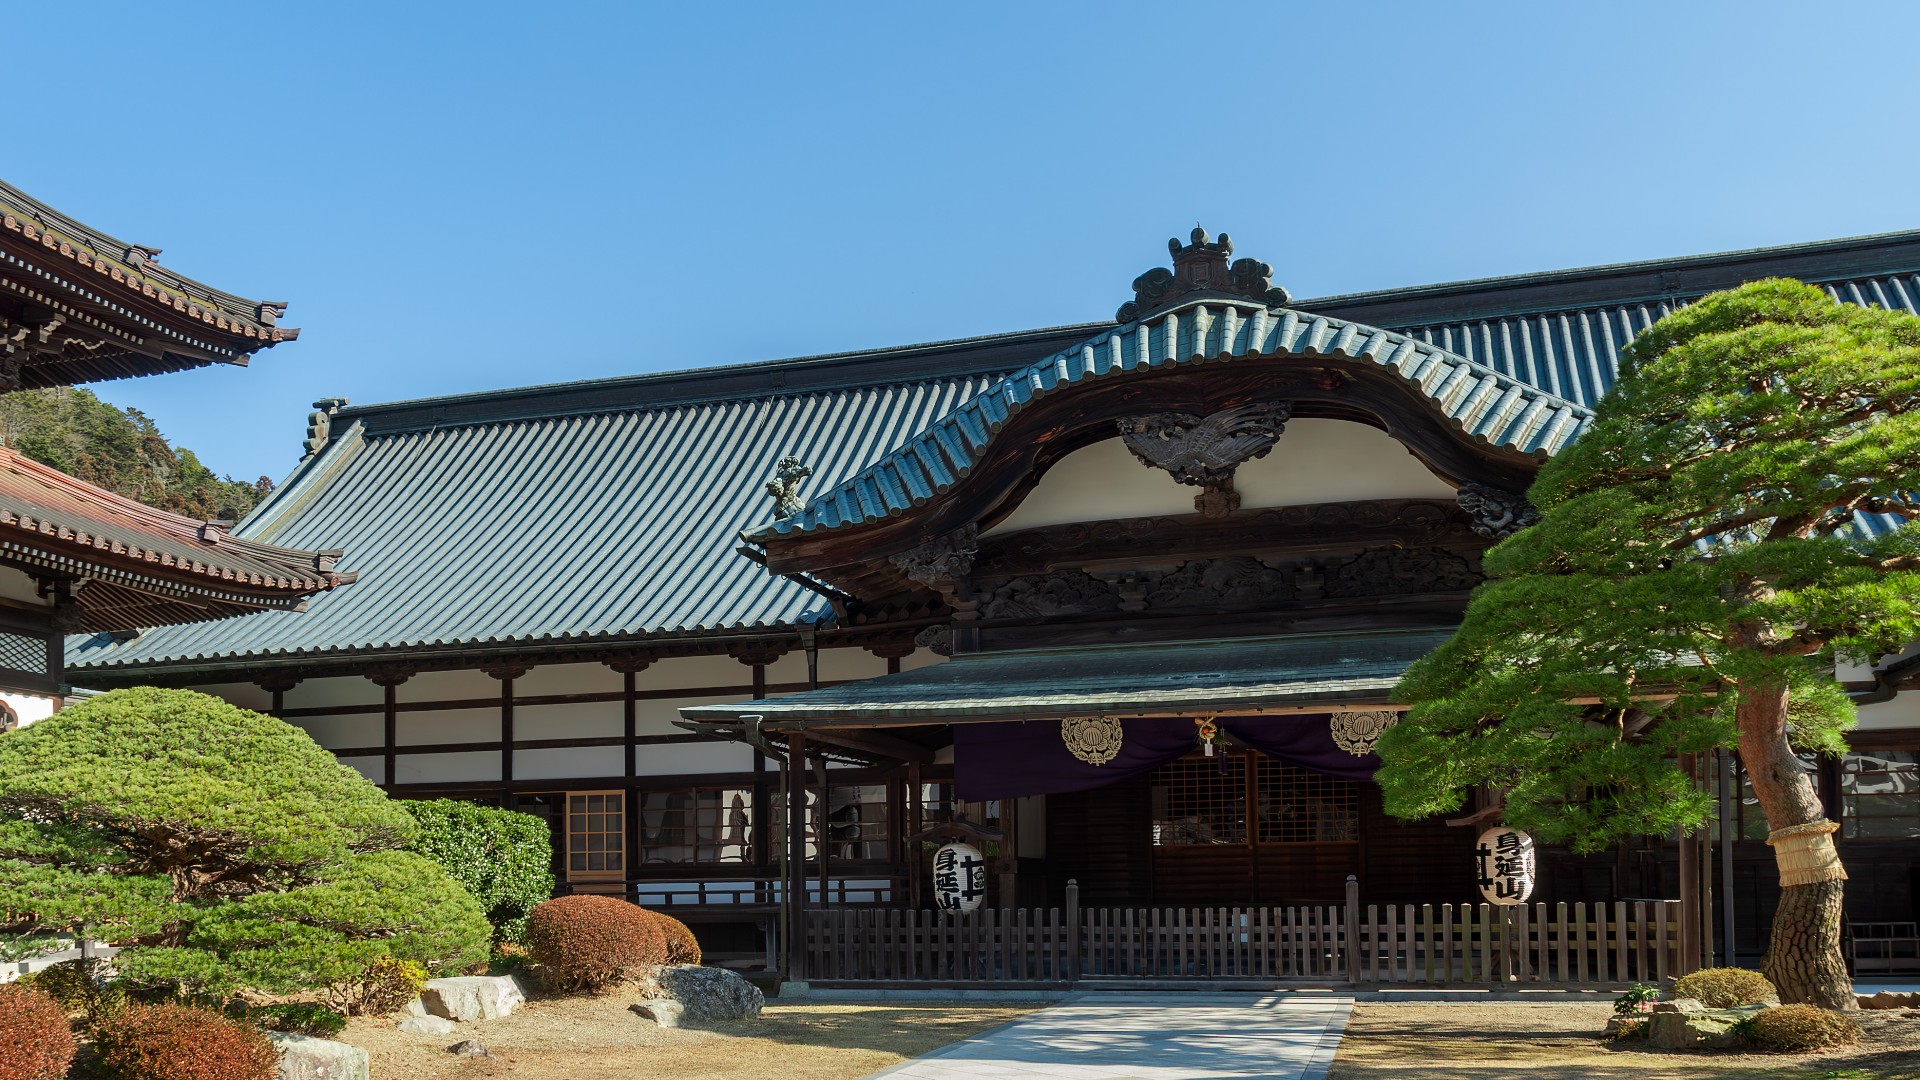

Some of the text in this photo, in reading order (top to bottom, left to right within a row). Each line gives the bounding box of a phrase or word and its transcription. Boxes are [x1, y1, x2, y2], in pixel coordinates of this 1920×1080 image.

[936, 848, 961, 909] 身延山
[1495, 832, 1524, 900] 身延山
